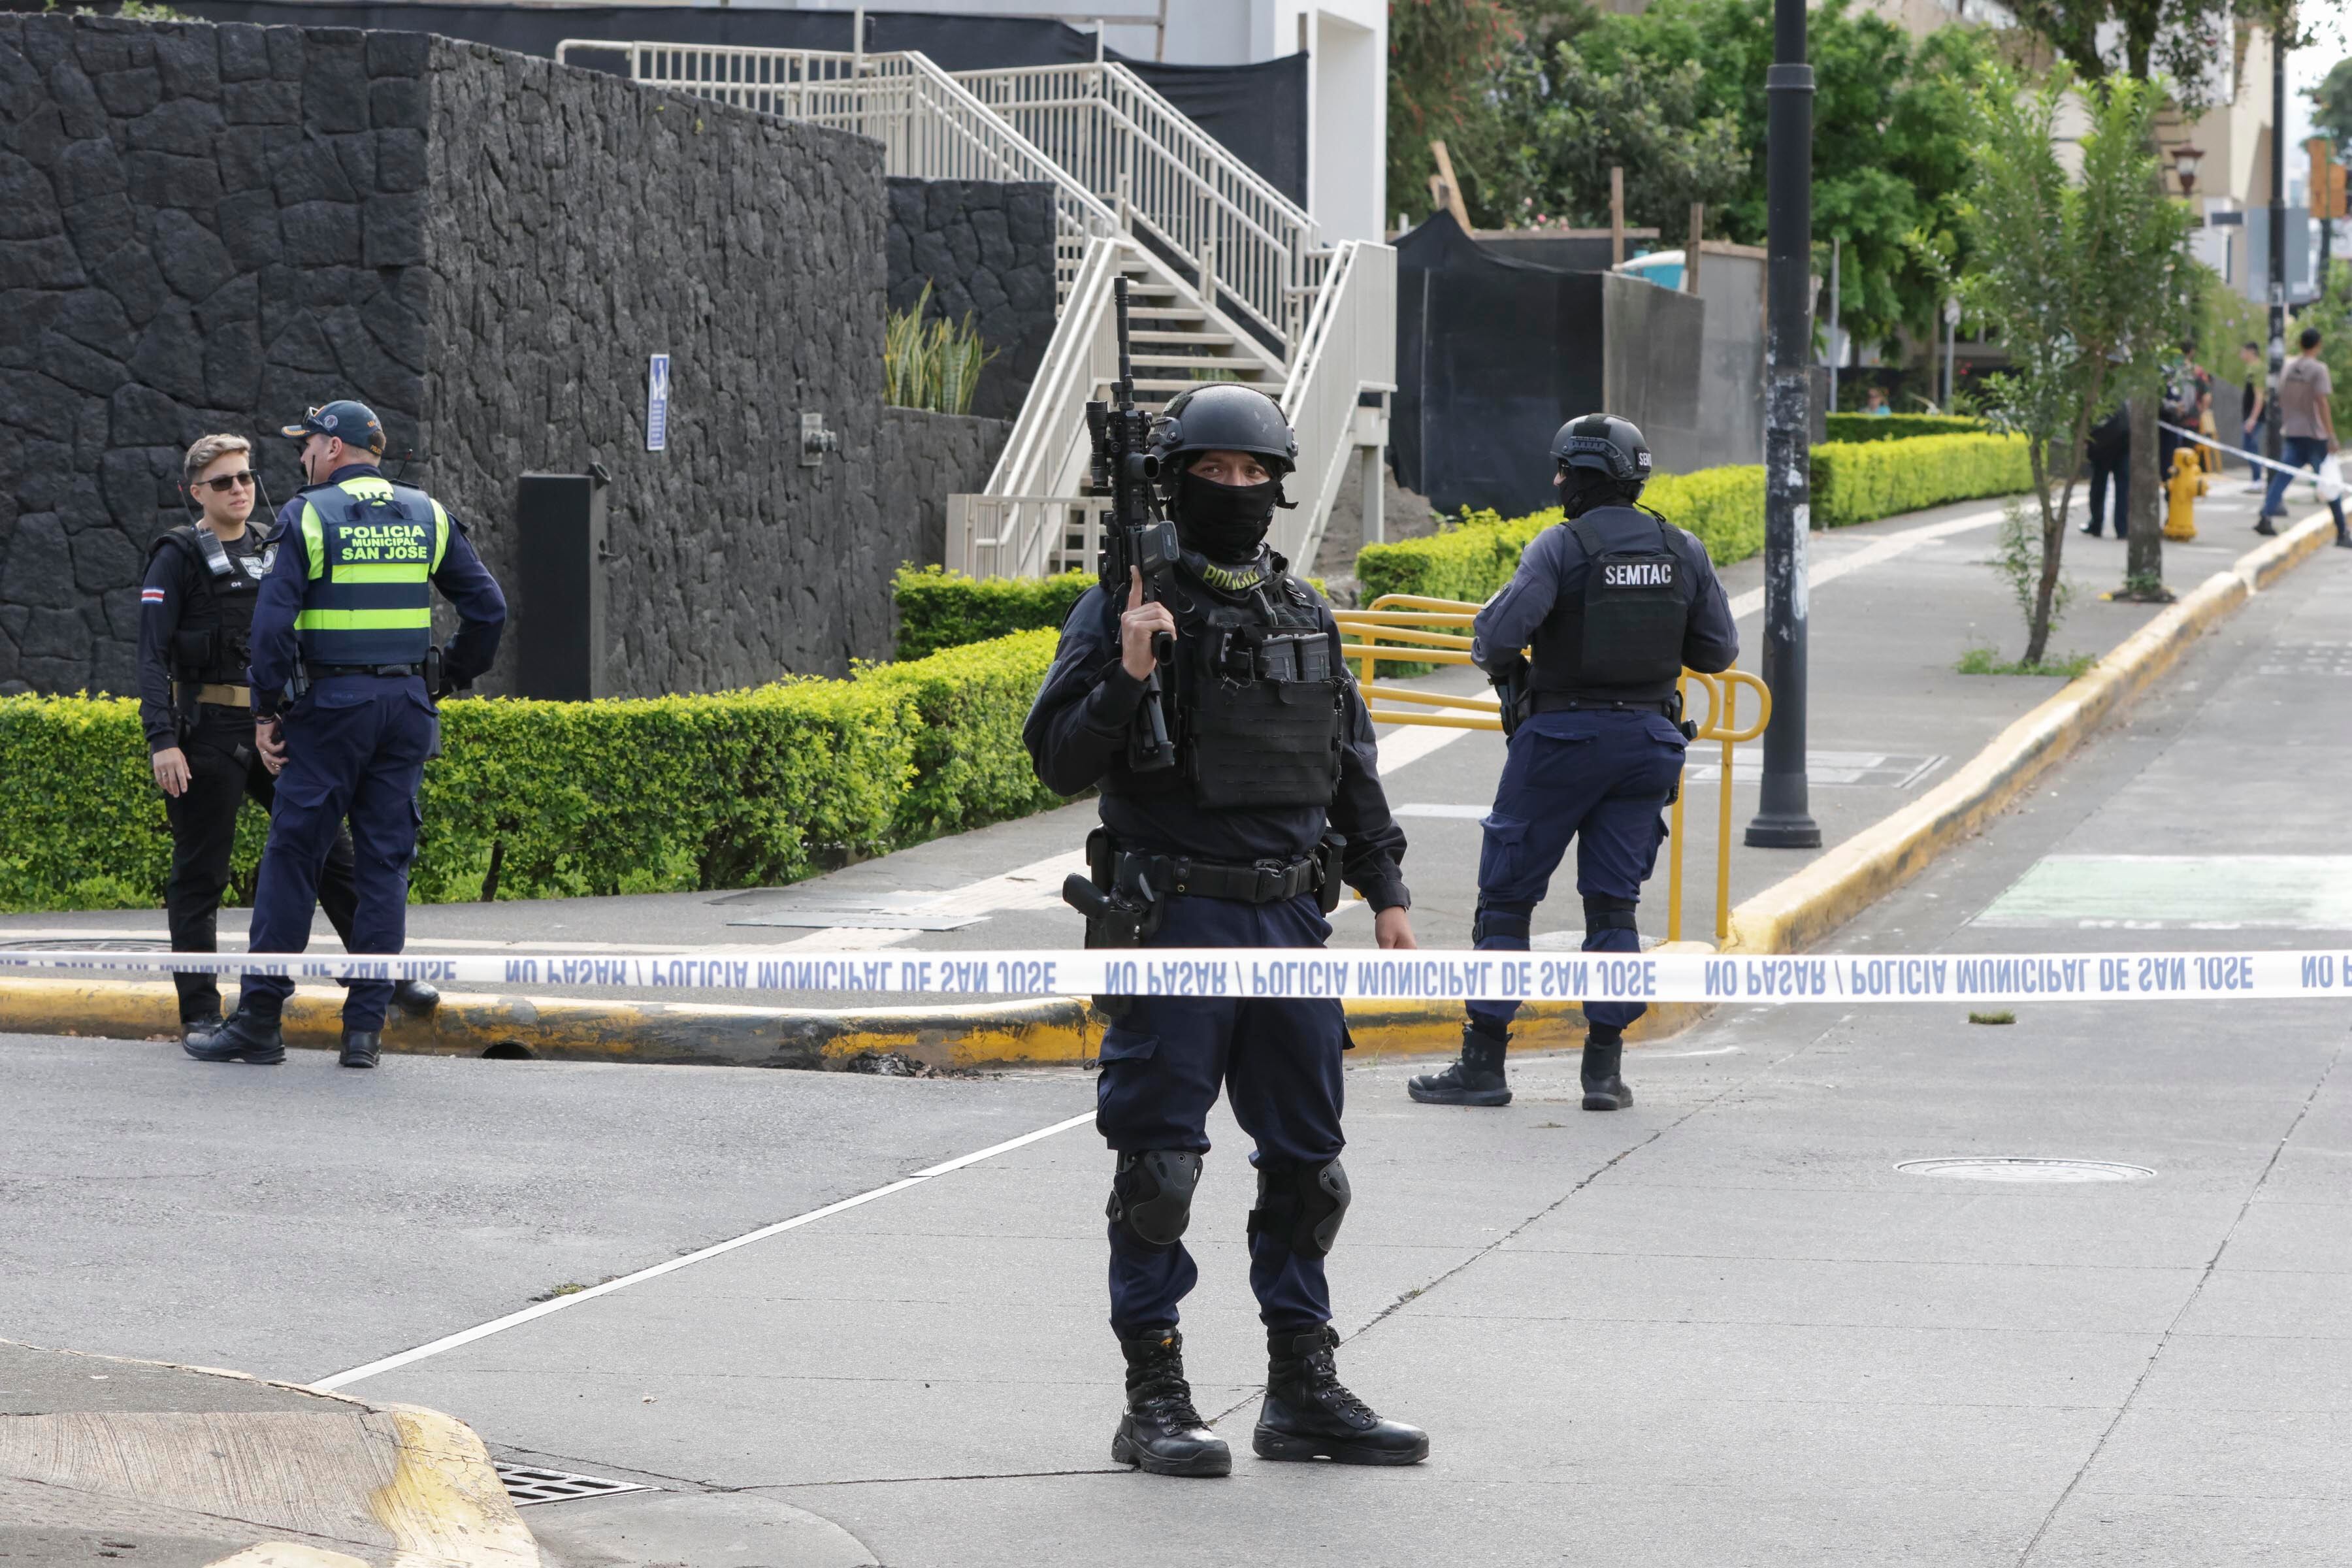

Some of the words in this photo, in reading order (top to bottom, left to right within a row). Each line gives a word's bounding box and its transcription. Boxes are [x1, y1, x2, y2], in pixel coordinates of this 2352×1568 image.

[339, 525, 426, 539] POLICIA
[351, 538, 418, 547] MUNICIPAL
[342, 547, 380, 561] SAN
[384, 546, 427, 559] JOSE
[1605, 564, 1672, 585] SEMTAC
